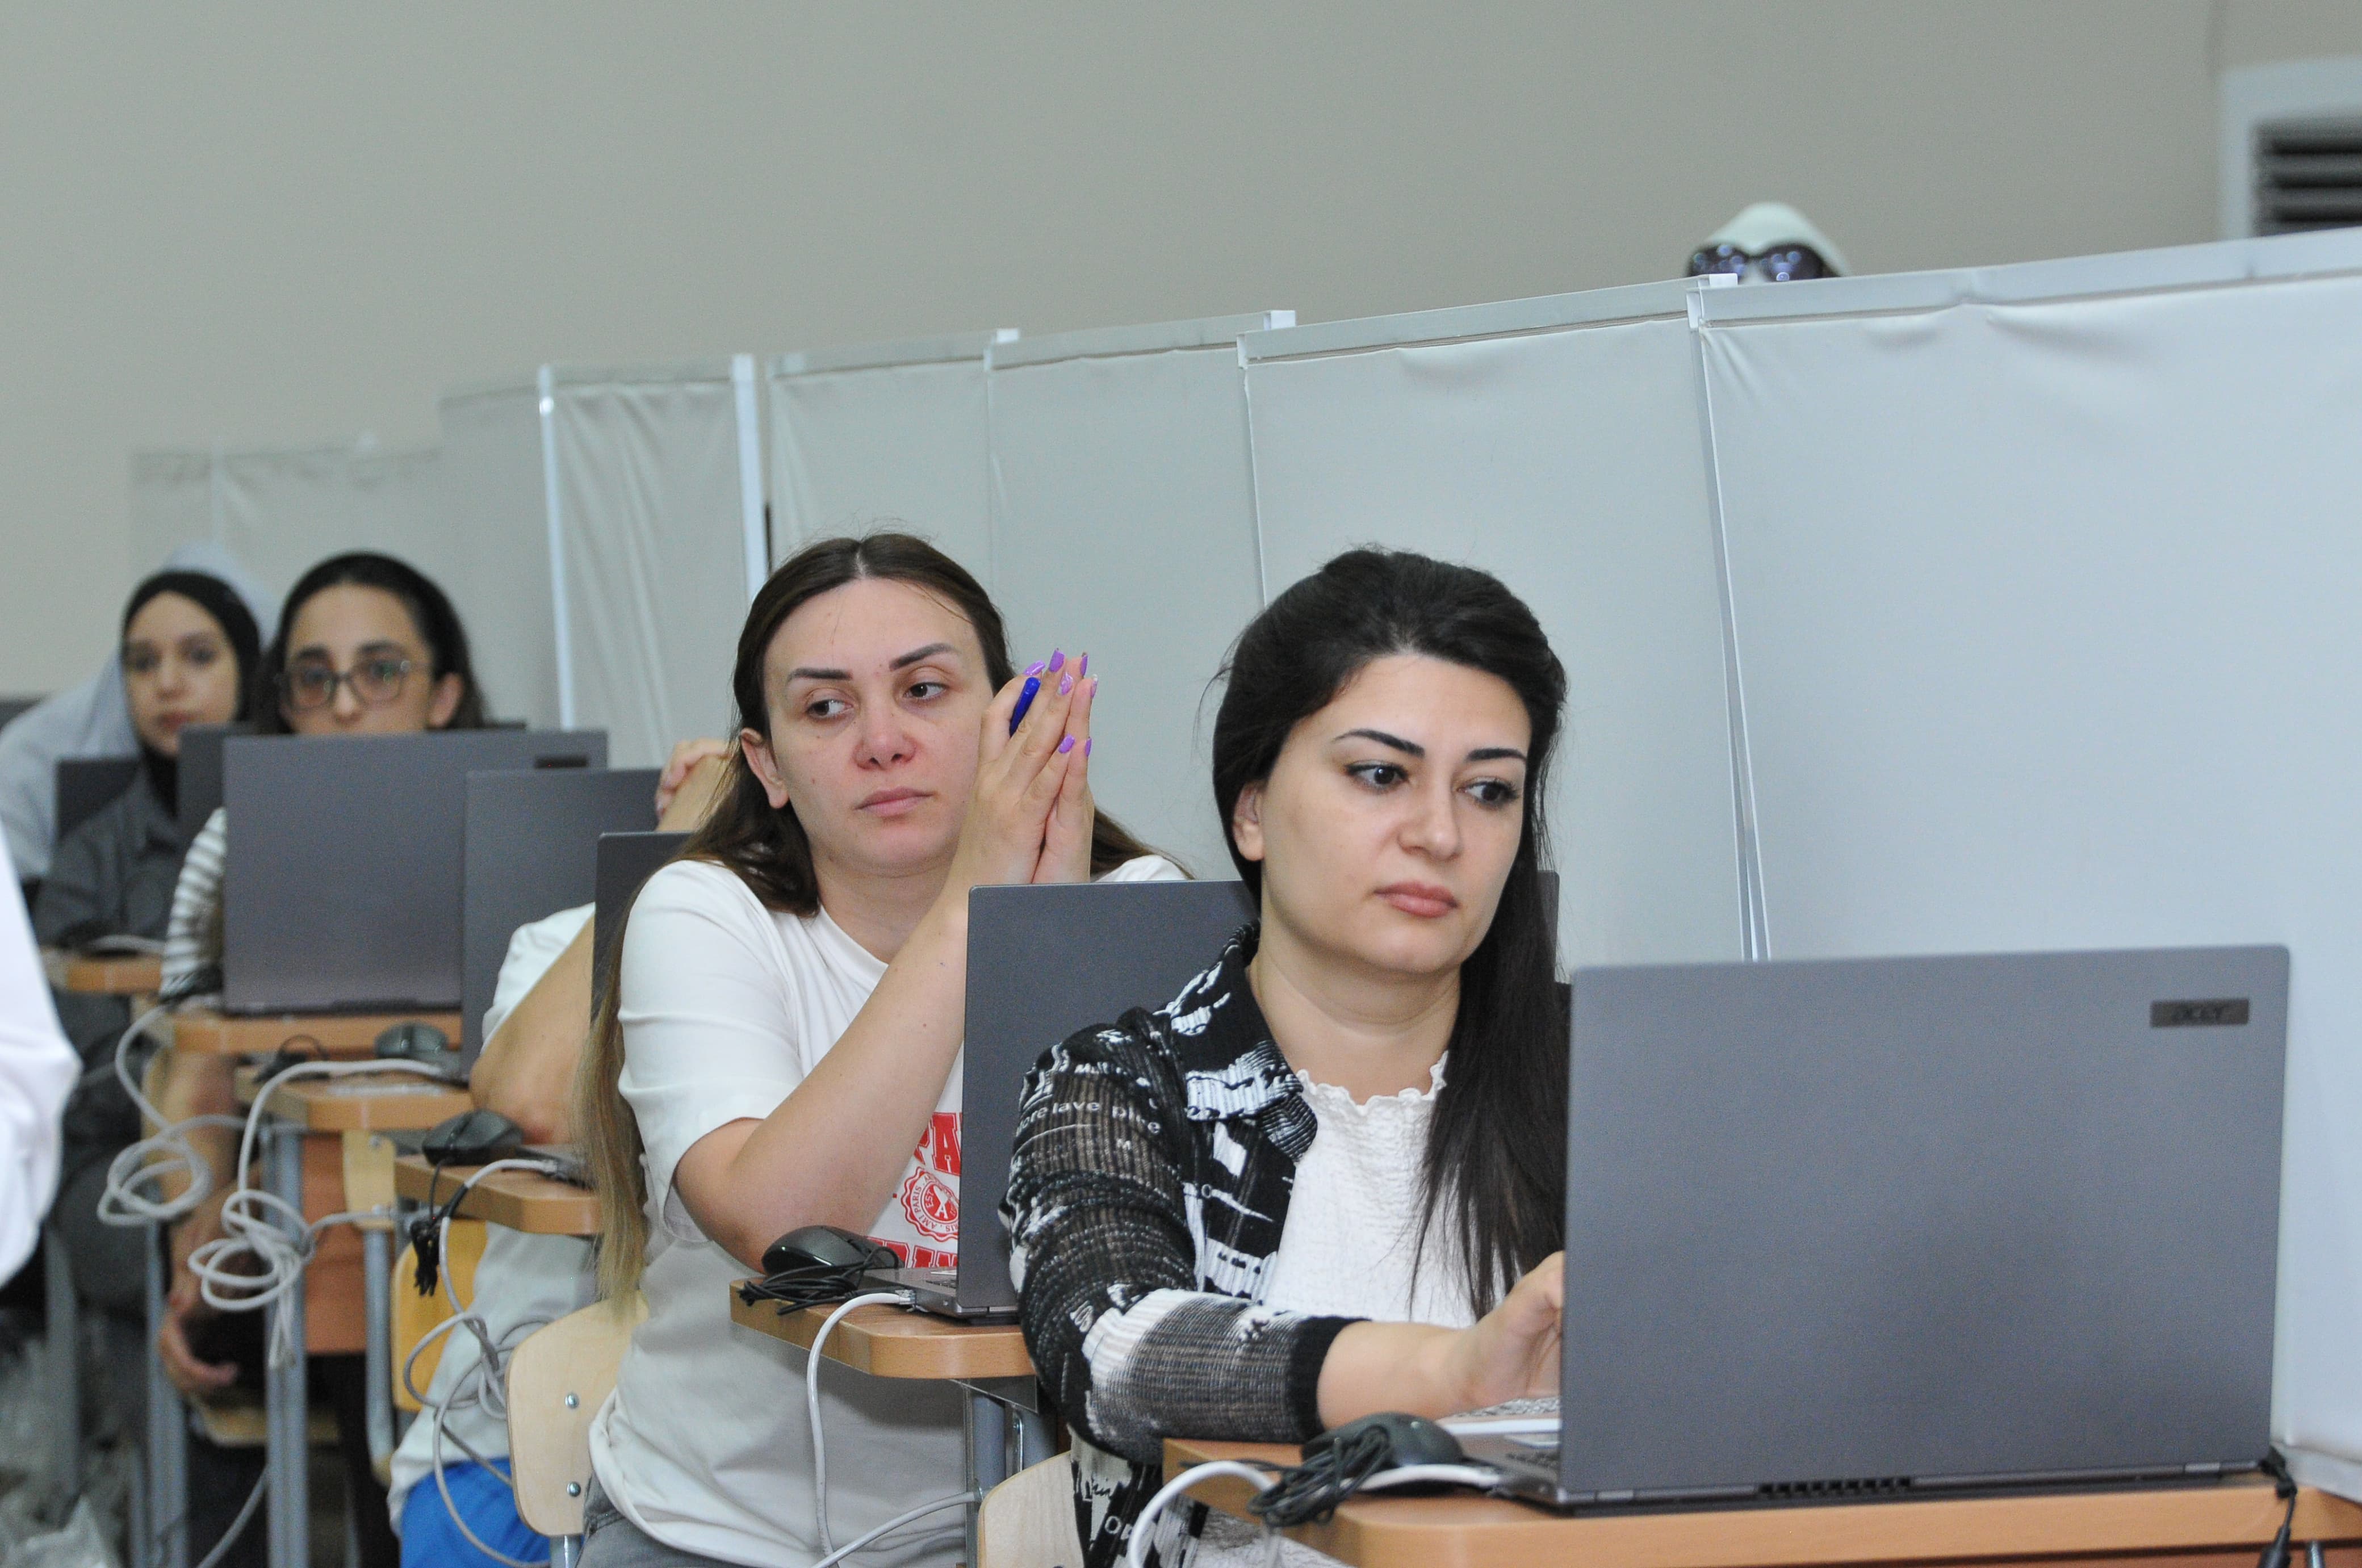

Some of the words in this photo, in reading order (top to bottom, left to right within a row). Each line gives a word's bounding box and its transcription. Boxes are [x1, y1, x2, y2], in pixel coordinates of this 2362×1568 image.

[912, 1186, 922, 1214] PARIS
[925, 1190, 935, 1209] EST
[918, 1213, 937, 1230] AMI
